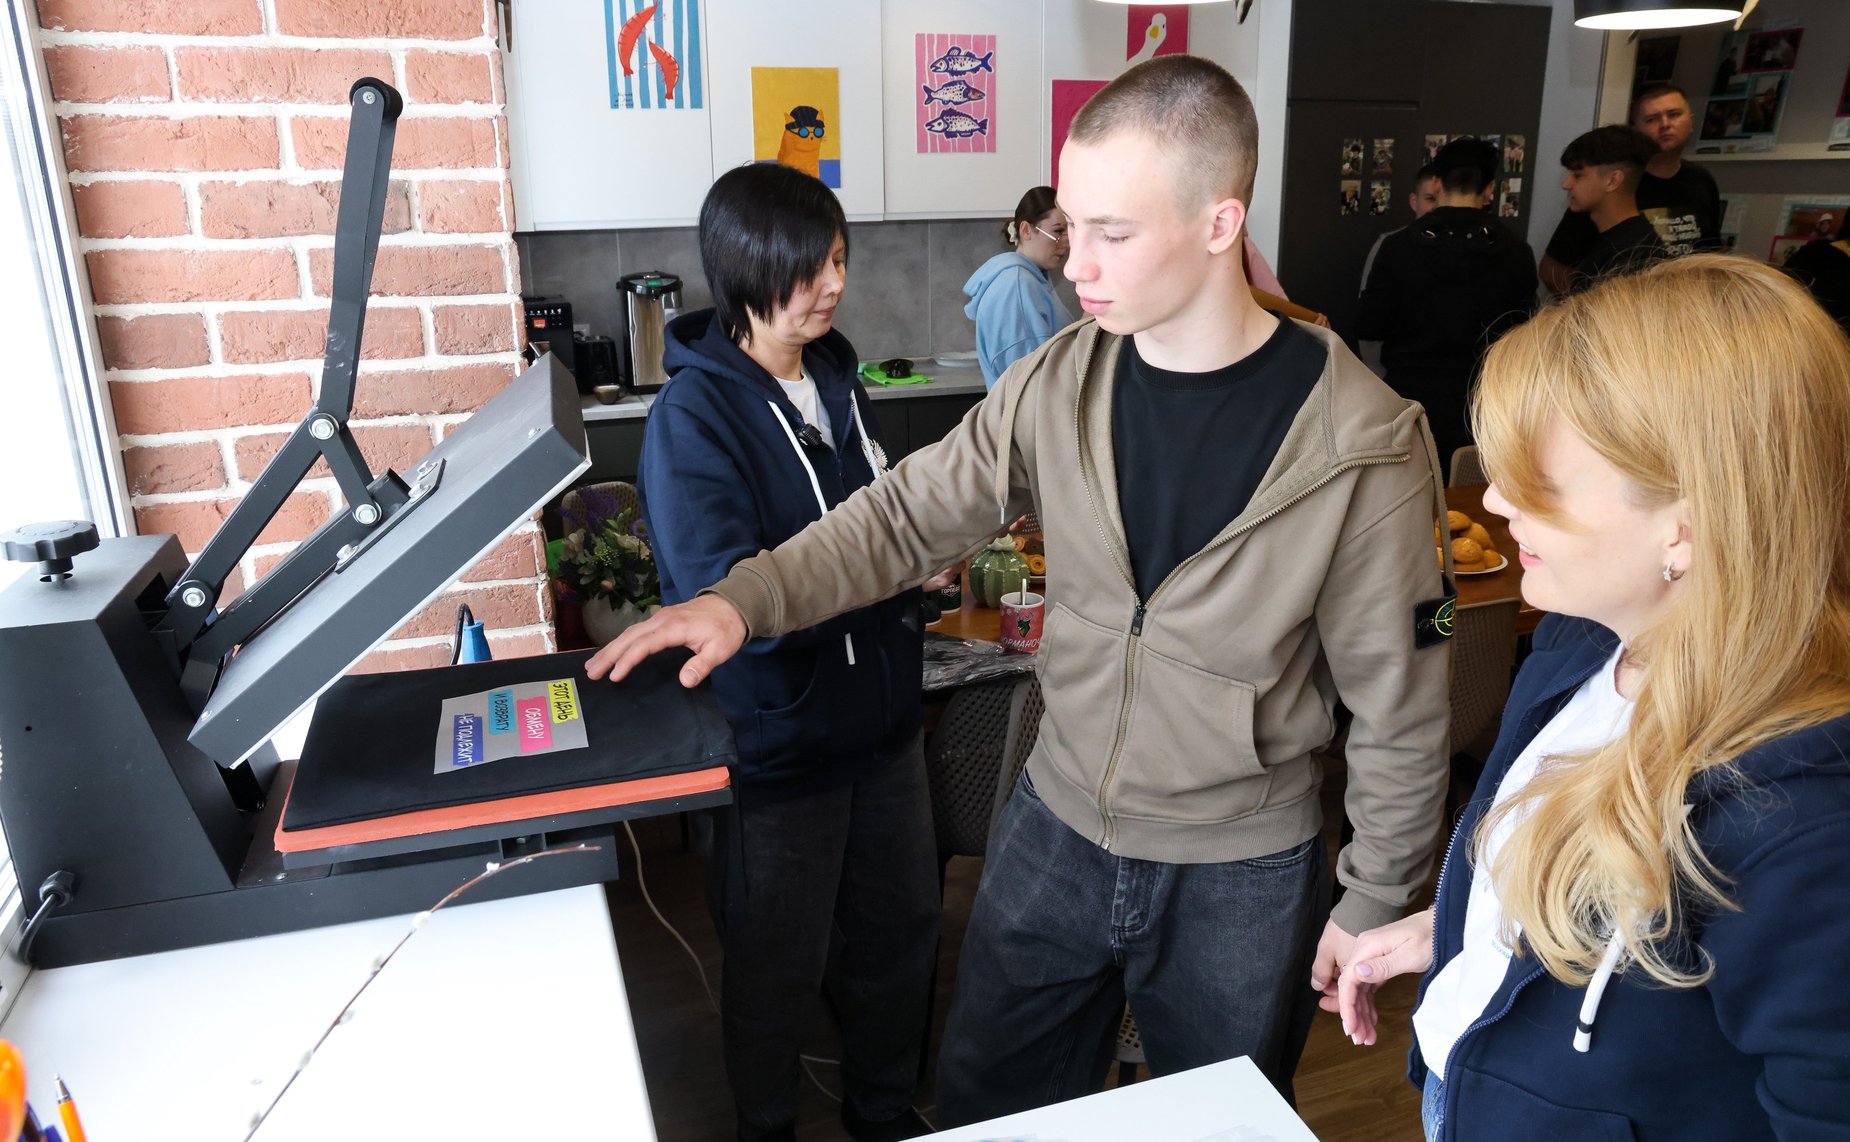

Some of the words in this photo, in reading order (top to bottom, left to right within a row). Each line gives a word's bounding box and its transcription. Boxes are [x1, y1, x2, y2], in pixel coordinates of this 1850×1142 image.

[553, 682, 570, 700] ЭТОТ
[459, 713, 474, 724] НЕ
[494, 699, 510, 731] ВОЗВРАТУ
[524, 707, 545, 739] ОБМЕНУ
[557, 700, 573, 721] ДЕНЬ
[457, 724, 473, 763] ПОДЛЕЖИТ
